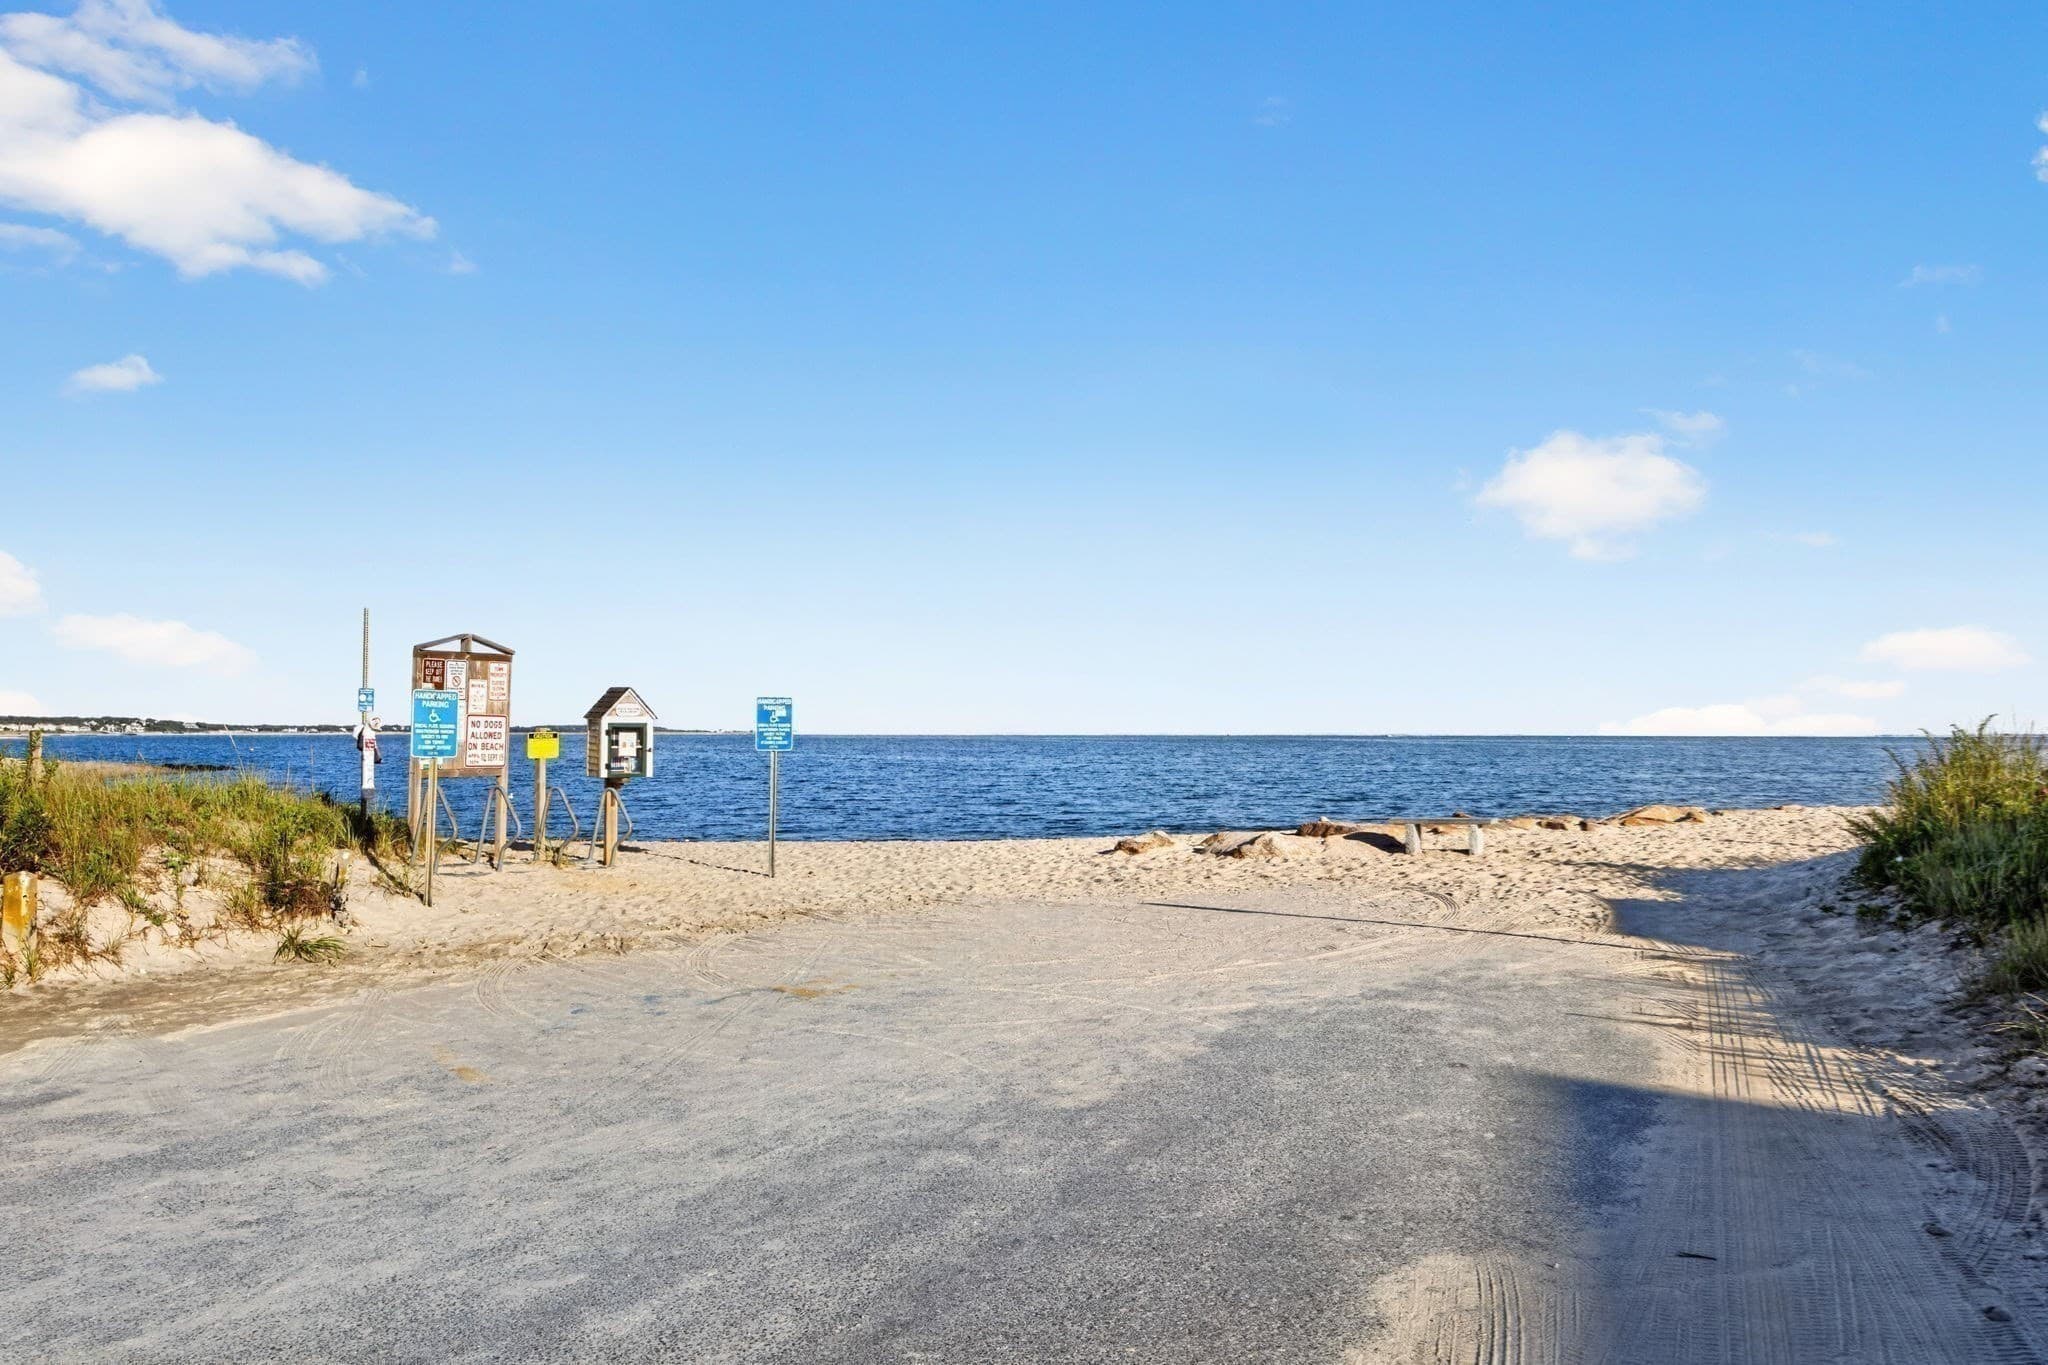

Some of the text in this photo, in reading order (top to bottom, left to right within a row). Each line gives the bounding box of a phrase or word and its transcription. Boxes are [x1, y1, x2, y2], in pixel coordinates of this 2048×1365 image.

[422, 700, 449, 708] PARKING
[471, 720, 502, 728] NO DOGS
[470, 731, 502, 739] ALLOWED
[468, 742, 503, 751] ON BEACH
